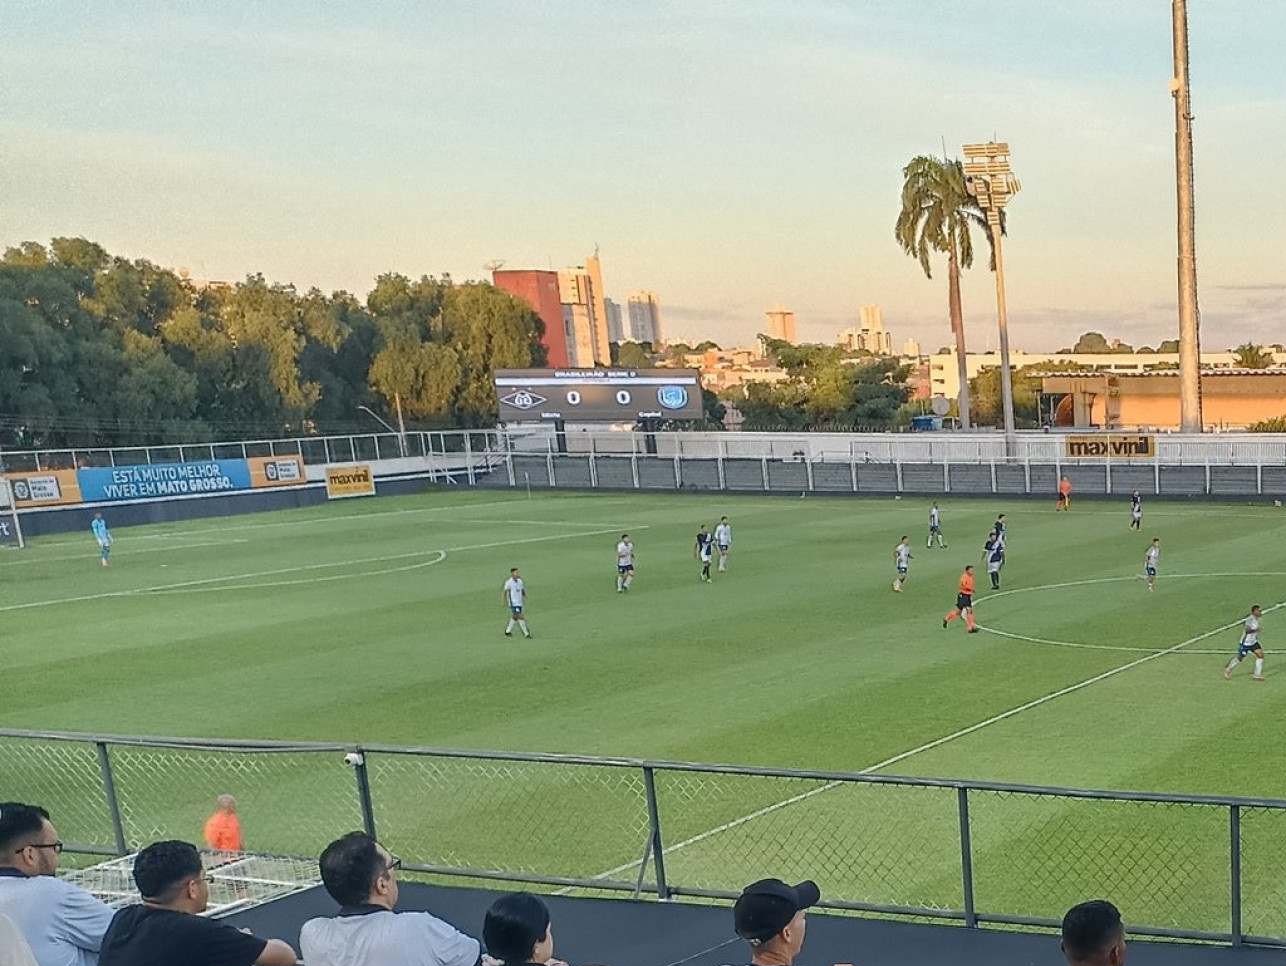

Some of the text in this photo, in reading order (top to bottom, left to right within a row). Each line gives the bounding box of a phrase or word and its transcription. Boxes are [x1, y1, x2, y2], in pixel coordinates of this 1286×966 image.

[567, 390, 581, 405] 0
[616, 390, 631, 405] 0
[112, 463, 220, 483] ESTÁ MUITO MELHOR
[330, 467, 369, 484] maxvinil
[103, 483, 139, 498] VIVER
[140, 482, 158, 496] EM
[157, 480, 187, 495] MATO
